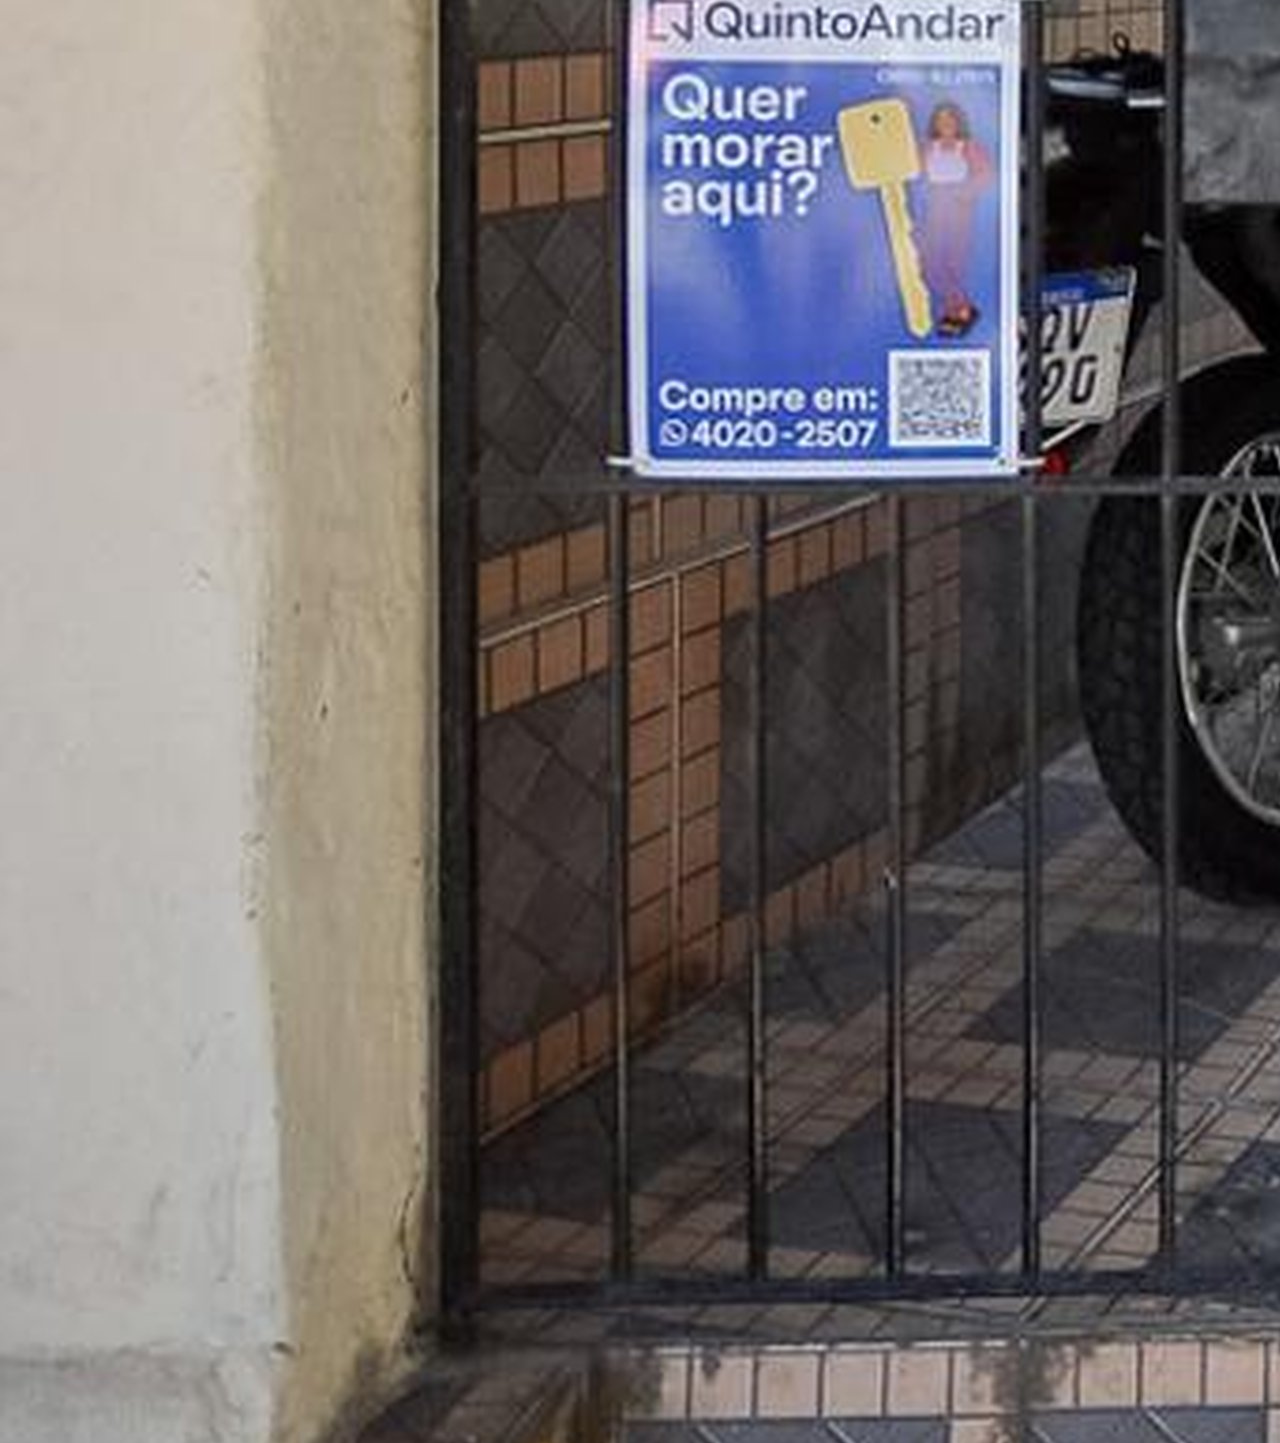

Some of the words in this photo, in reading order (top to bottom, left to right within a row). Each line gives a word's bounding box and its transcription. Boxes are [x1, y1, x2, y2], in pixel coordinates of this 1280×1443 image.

[703, 0, 1005, 41] QuintoAndar
[662, 73, 808, 121] Quer
[662, 132, 834, 168] morar
[662, 169, 818, 227] aqui?
[658, 379, 806, 417] Compre
[813, 387, 879, 412] em:
